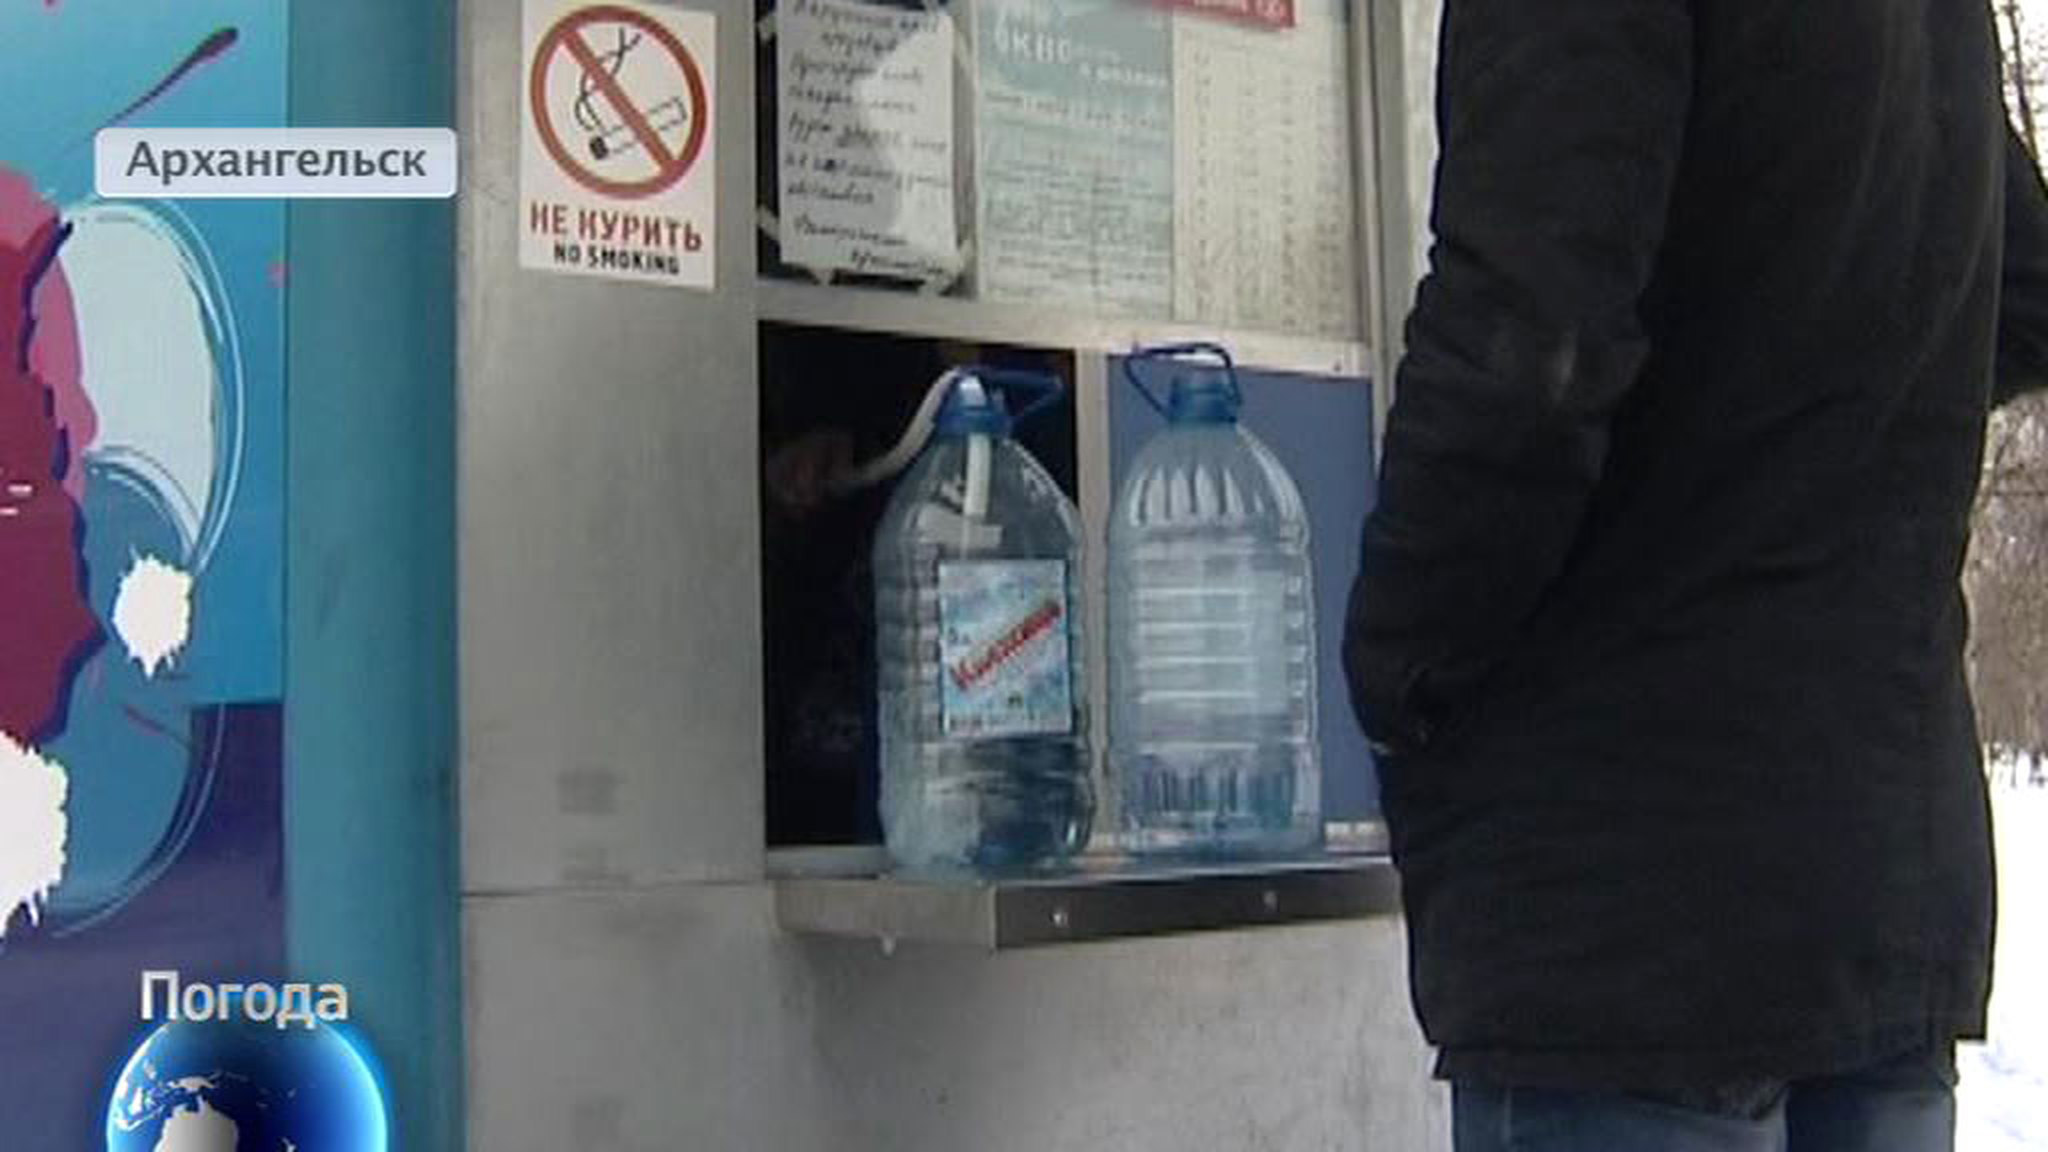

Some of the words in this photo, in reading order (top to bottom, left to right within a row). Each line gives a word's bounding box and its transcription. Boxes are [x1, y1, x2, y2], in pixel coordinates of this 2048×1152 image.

[530, 202, 568, 235] НЕ
[578, 208, 702, 252] КУРИТЬ
[554, 241, 581, 264] NO
[588, 246, 679, 275] SMOKING
